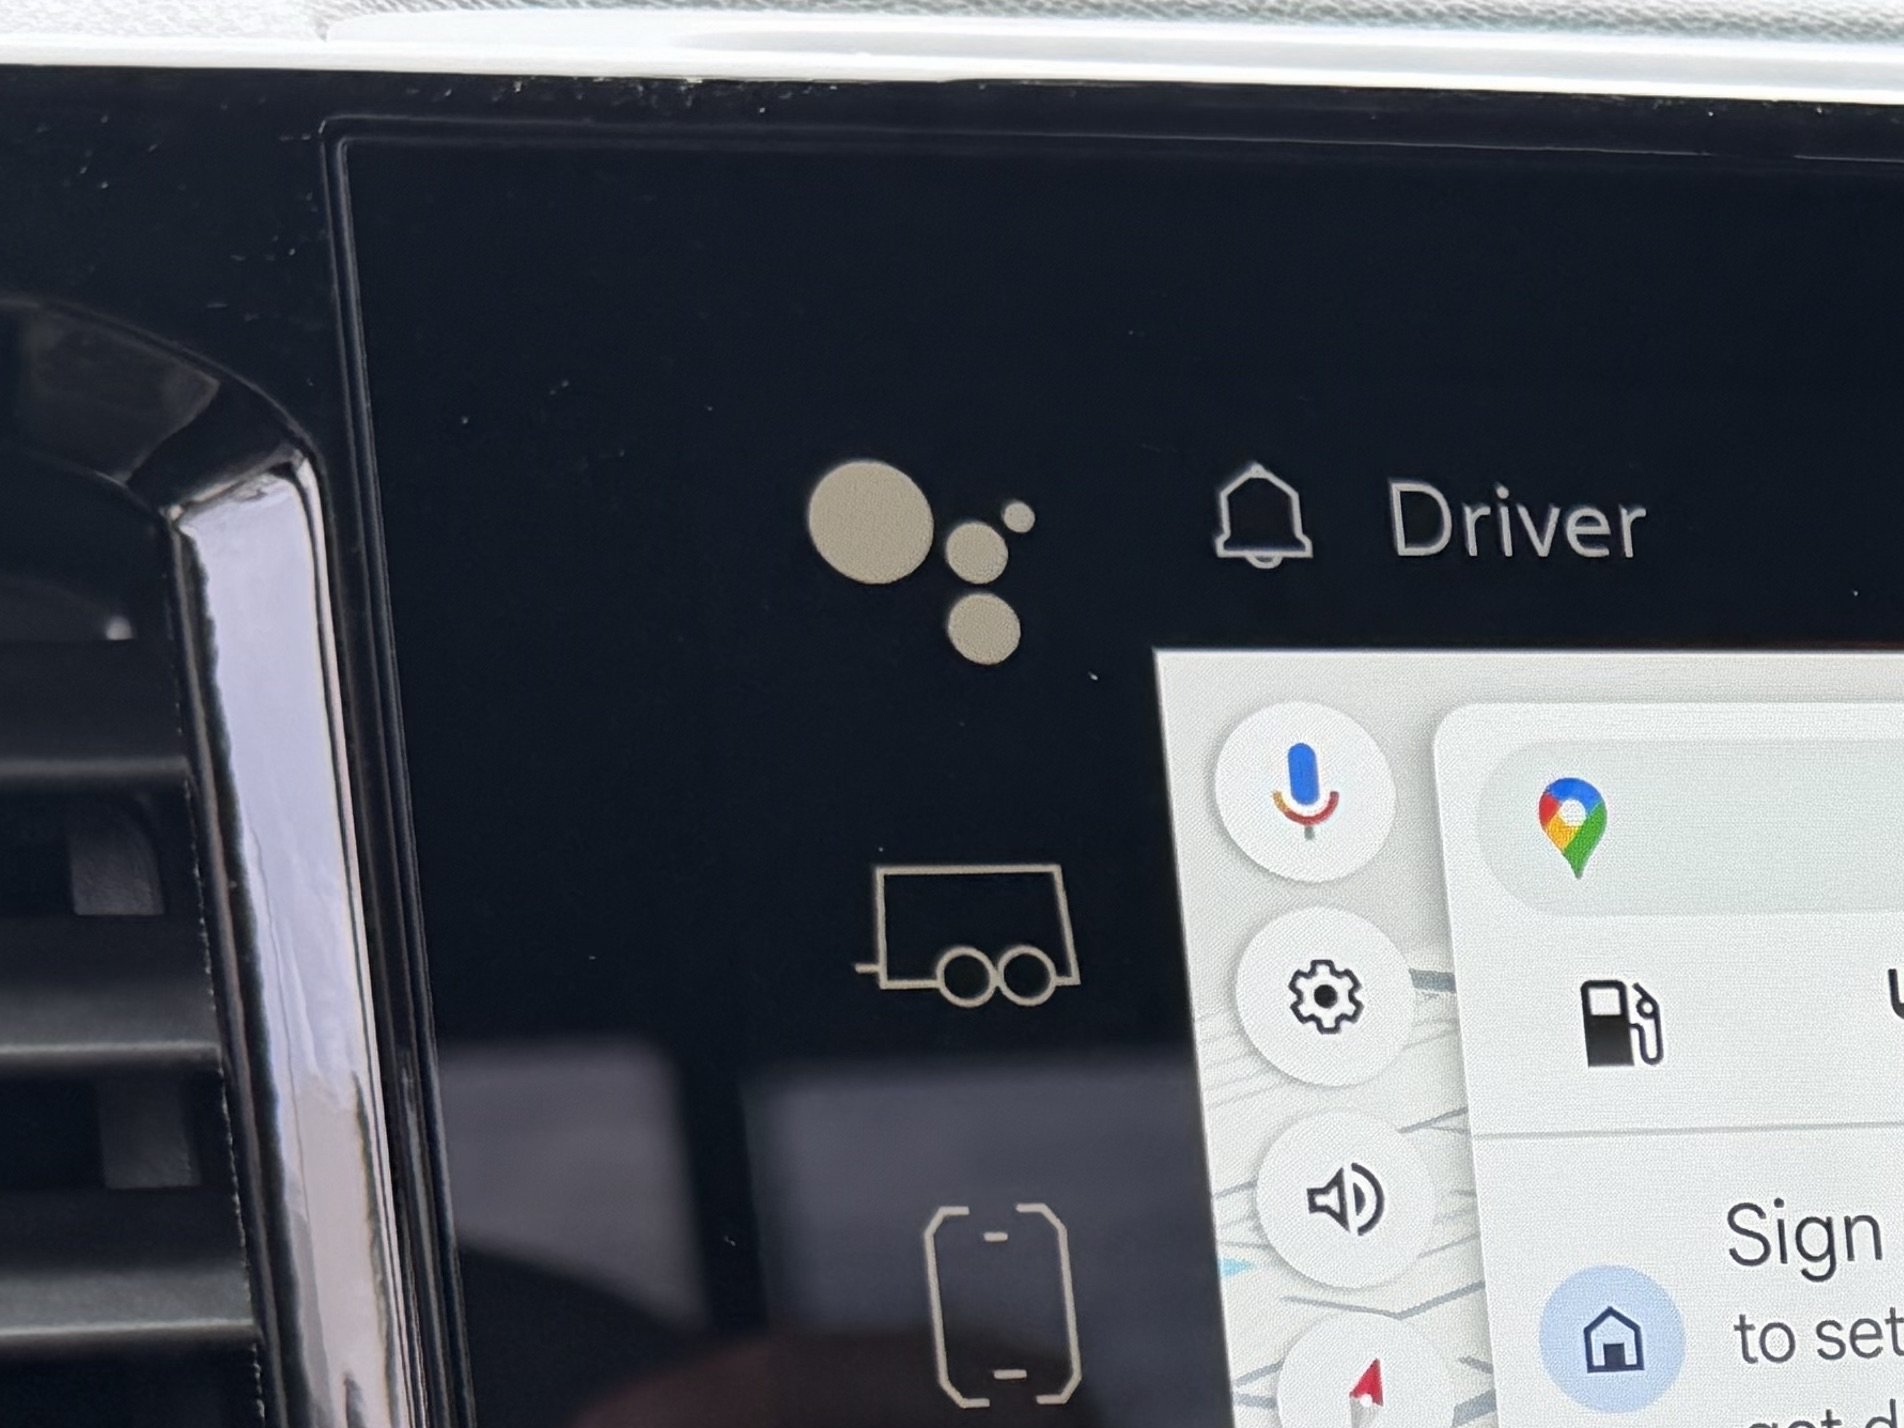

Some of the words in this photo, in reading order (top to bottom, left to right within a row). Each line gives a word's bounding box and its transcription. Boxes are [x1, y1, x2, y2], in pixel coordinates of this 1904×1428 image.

[1388, 480, 1648, 559] Driver
[1725, 1196, 1884, 1284] Sign
[1732, 1312, 1797, 1366] to
